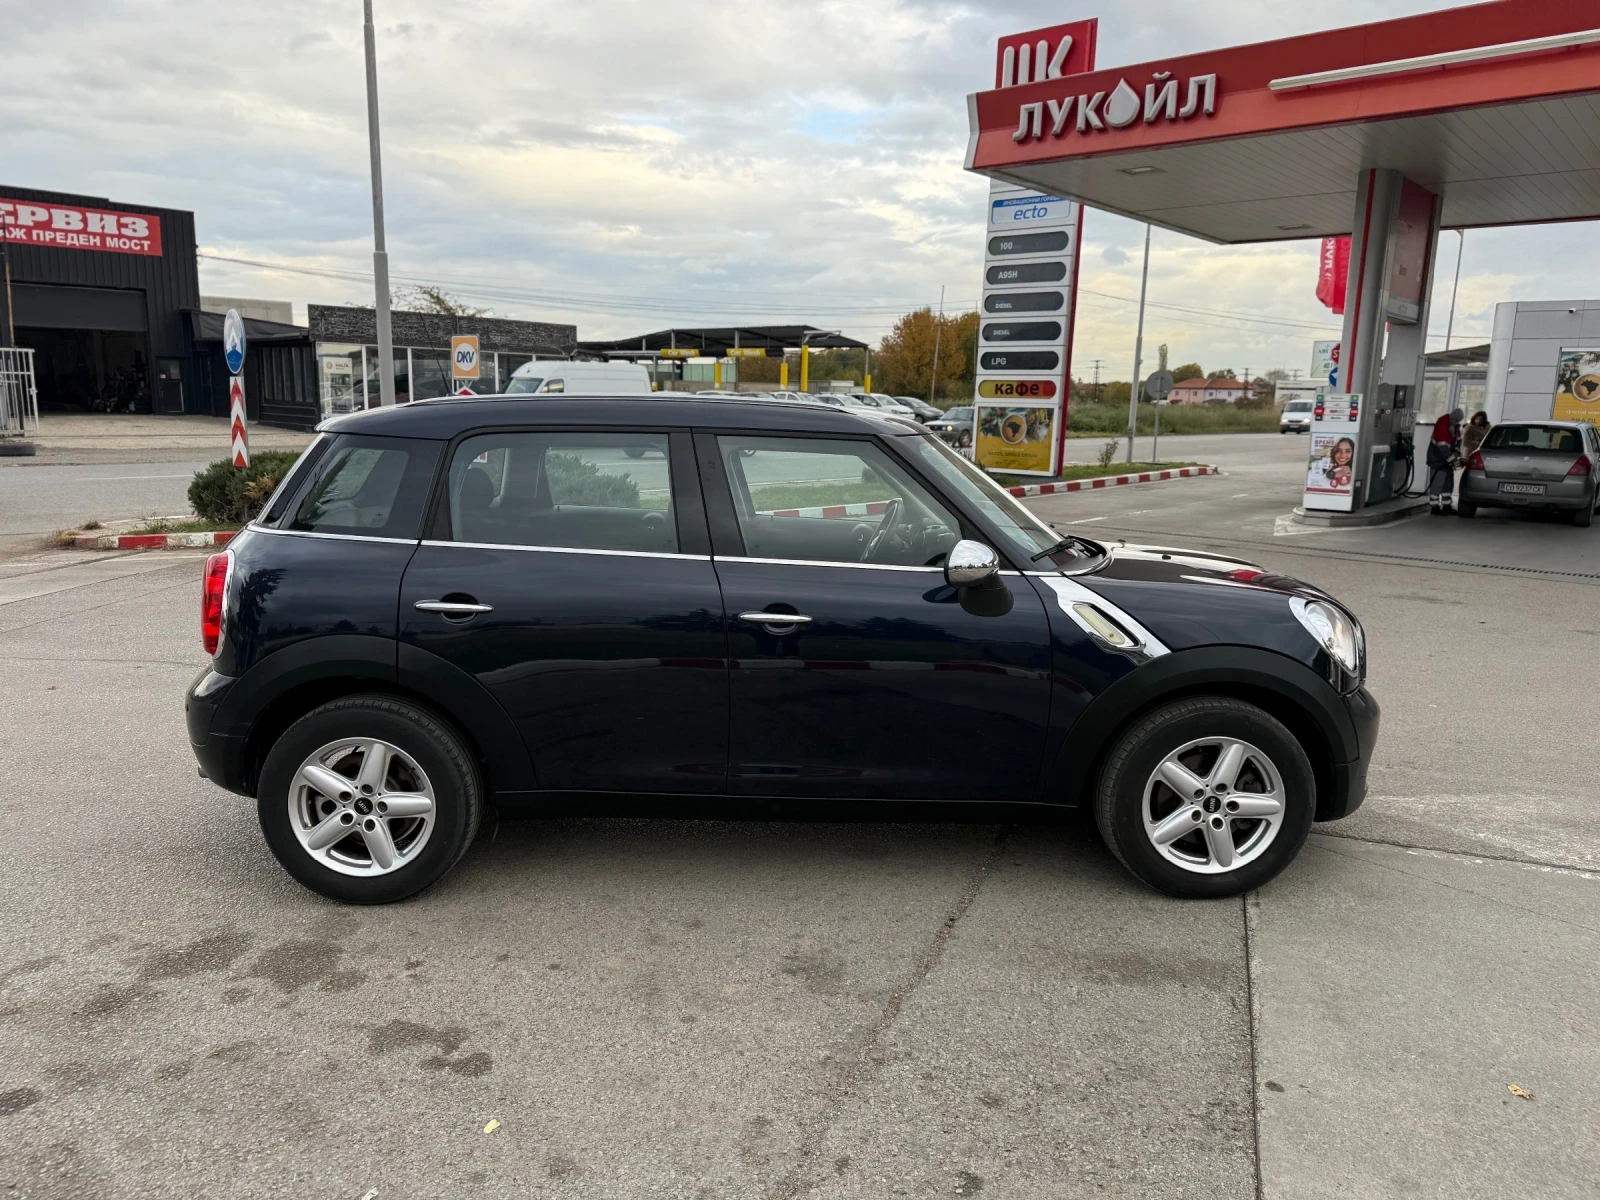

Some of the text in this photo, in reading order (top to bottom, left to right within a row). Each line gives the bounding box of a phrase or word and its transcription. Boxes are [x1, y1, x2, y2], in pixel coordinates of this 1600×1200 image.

[1014, 205, 1048, 220] ecto
[32, 229, 101, 247] ПРЕДЕН
[106, 236, 151, 251] МОСТ
[1000, 242, 1013, 250] 100
[456, 350, 474, 364] DKV
[994, 383, 1040, 396] кафе
[358, 800, 370, 813] MINI
